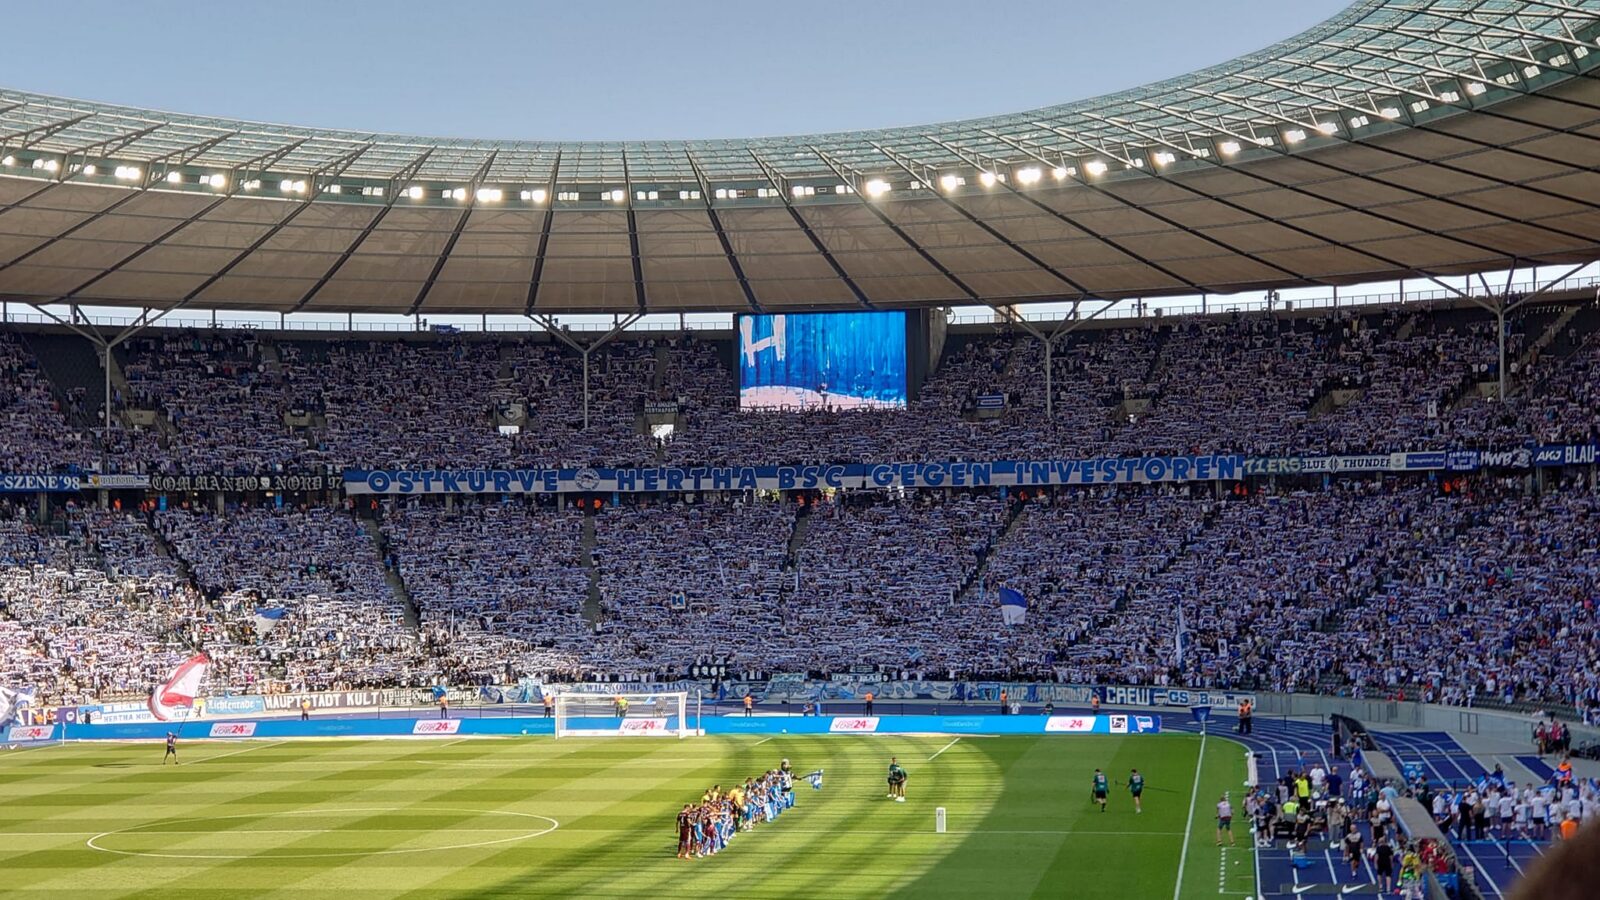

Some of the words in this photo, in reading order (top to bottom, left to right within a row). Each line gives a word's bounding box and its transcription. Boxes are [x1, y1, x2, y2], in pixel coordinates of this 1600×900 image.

[1302, 459, 1326, 470] BLUE
[366, 469, 560, 493] OSTKURVE
[615, 467, 758, 491] HERTHA
[777, 465, 845, 488] BSC
[871, 463, 993, 486] GEGEN
[1015, 455, 1240, 485] INVESTOREN
[275, 475, 322, 491] NORD
[265, 693, 341, 709] HAUPTSTADT
[347, 692, 379, 706] KULT
[422, 691, 471, 702] HOGANS
[1106, 687, 1149, 705] CREW
